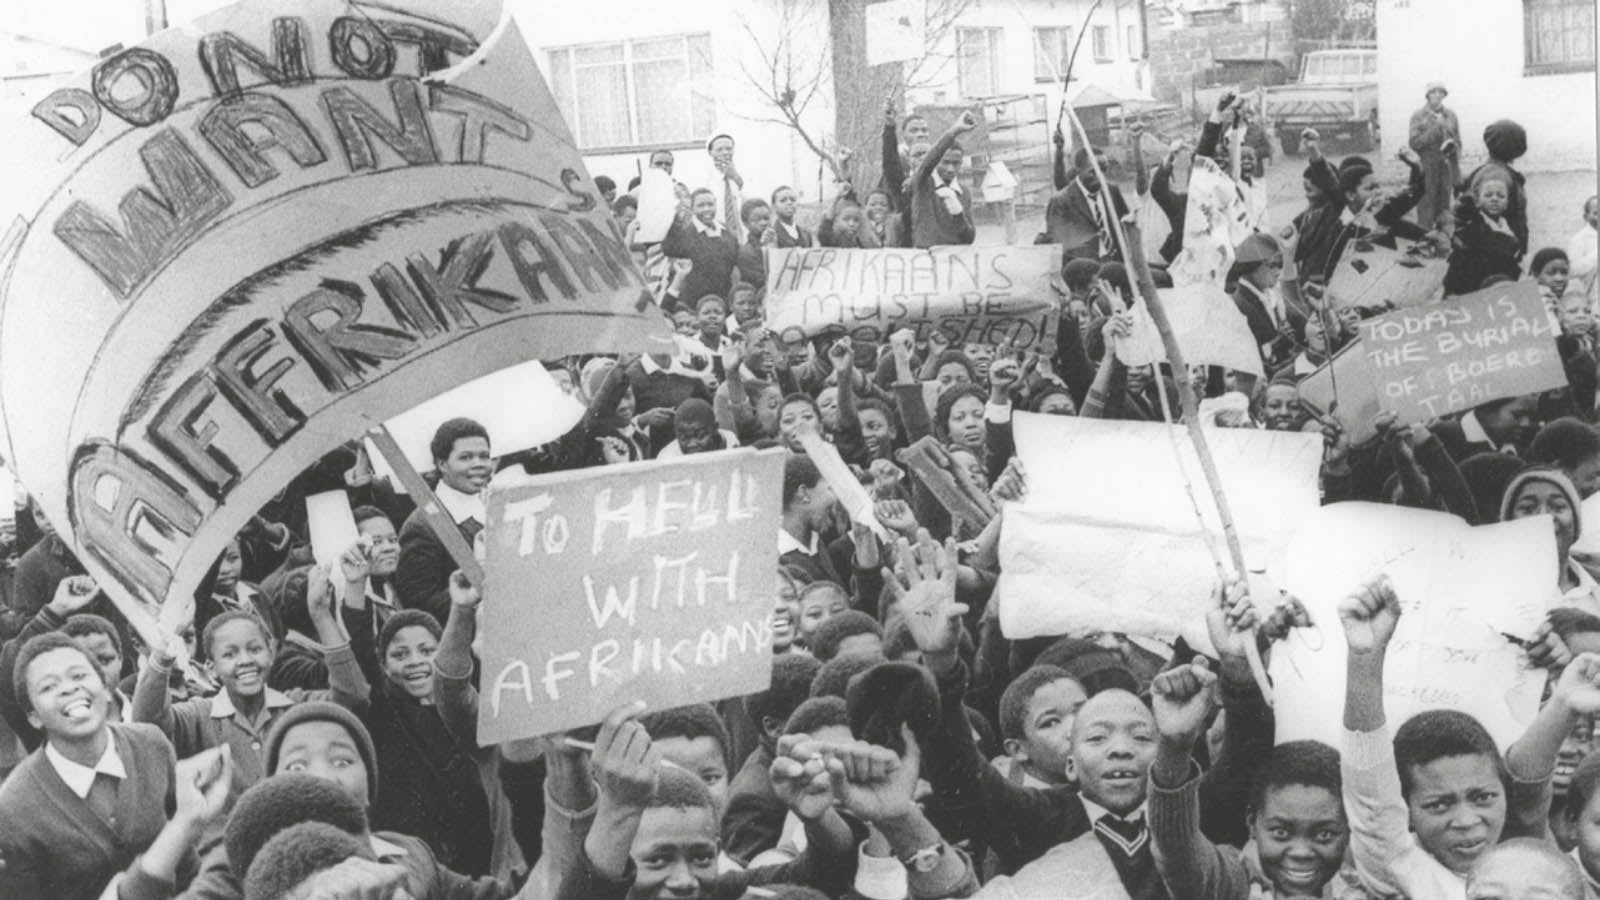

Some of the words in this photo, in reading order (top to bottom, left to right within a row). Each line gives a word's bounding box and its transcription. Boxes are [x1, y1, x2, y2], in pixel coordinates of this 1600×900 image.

[31, 46, 180, 147] DO
[199, 15, 481, 105] NOT
[54, 79, 533, 302] WANT
[775, 249, 1014, 295] AFRIKAANS
[803, 292, 939, 325] MUST
[961, 291, 1014, 317] BE
[1359, 305, 1473, 342] TODAY
[1487, 295, 1517, 320] IS
[1368, 340, 1430, 368] THE
[1436, 317, 1552, 354] BURIAL
[1385, 375, 1420, 398] OF
[1416, 382, 1500, 417] TAAL
[502, 491, 570, 558] TO
[592, 467, 761, 556] HELL
[583, 550, 740, 629] WITH
